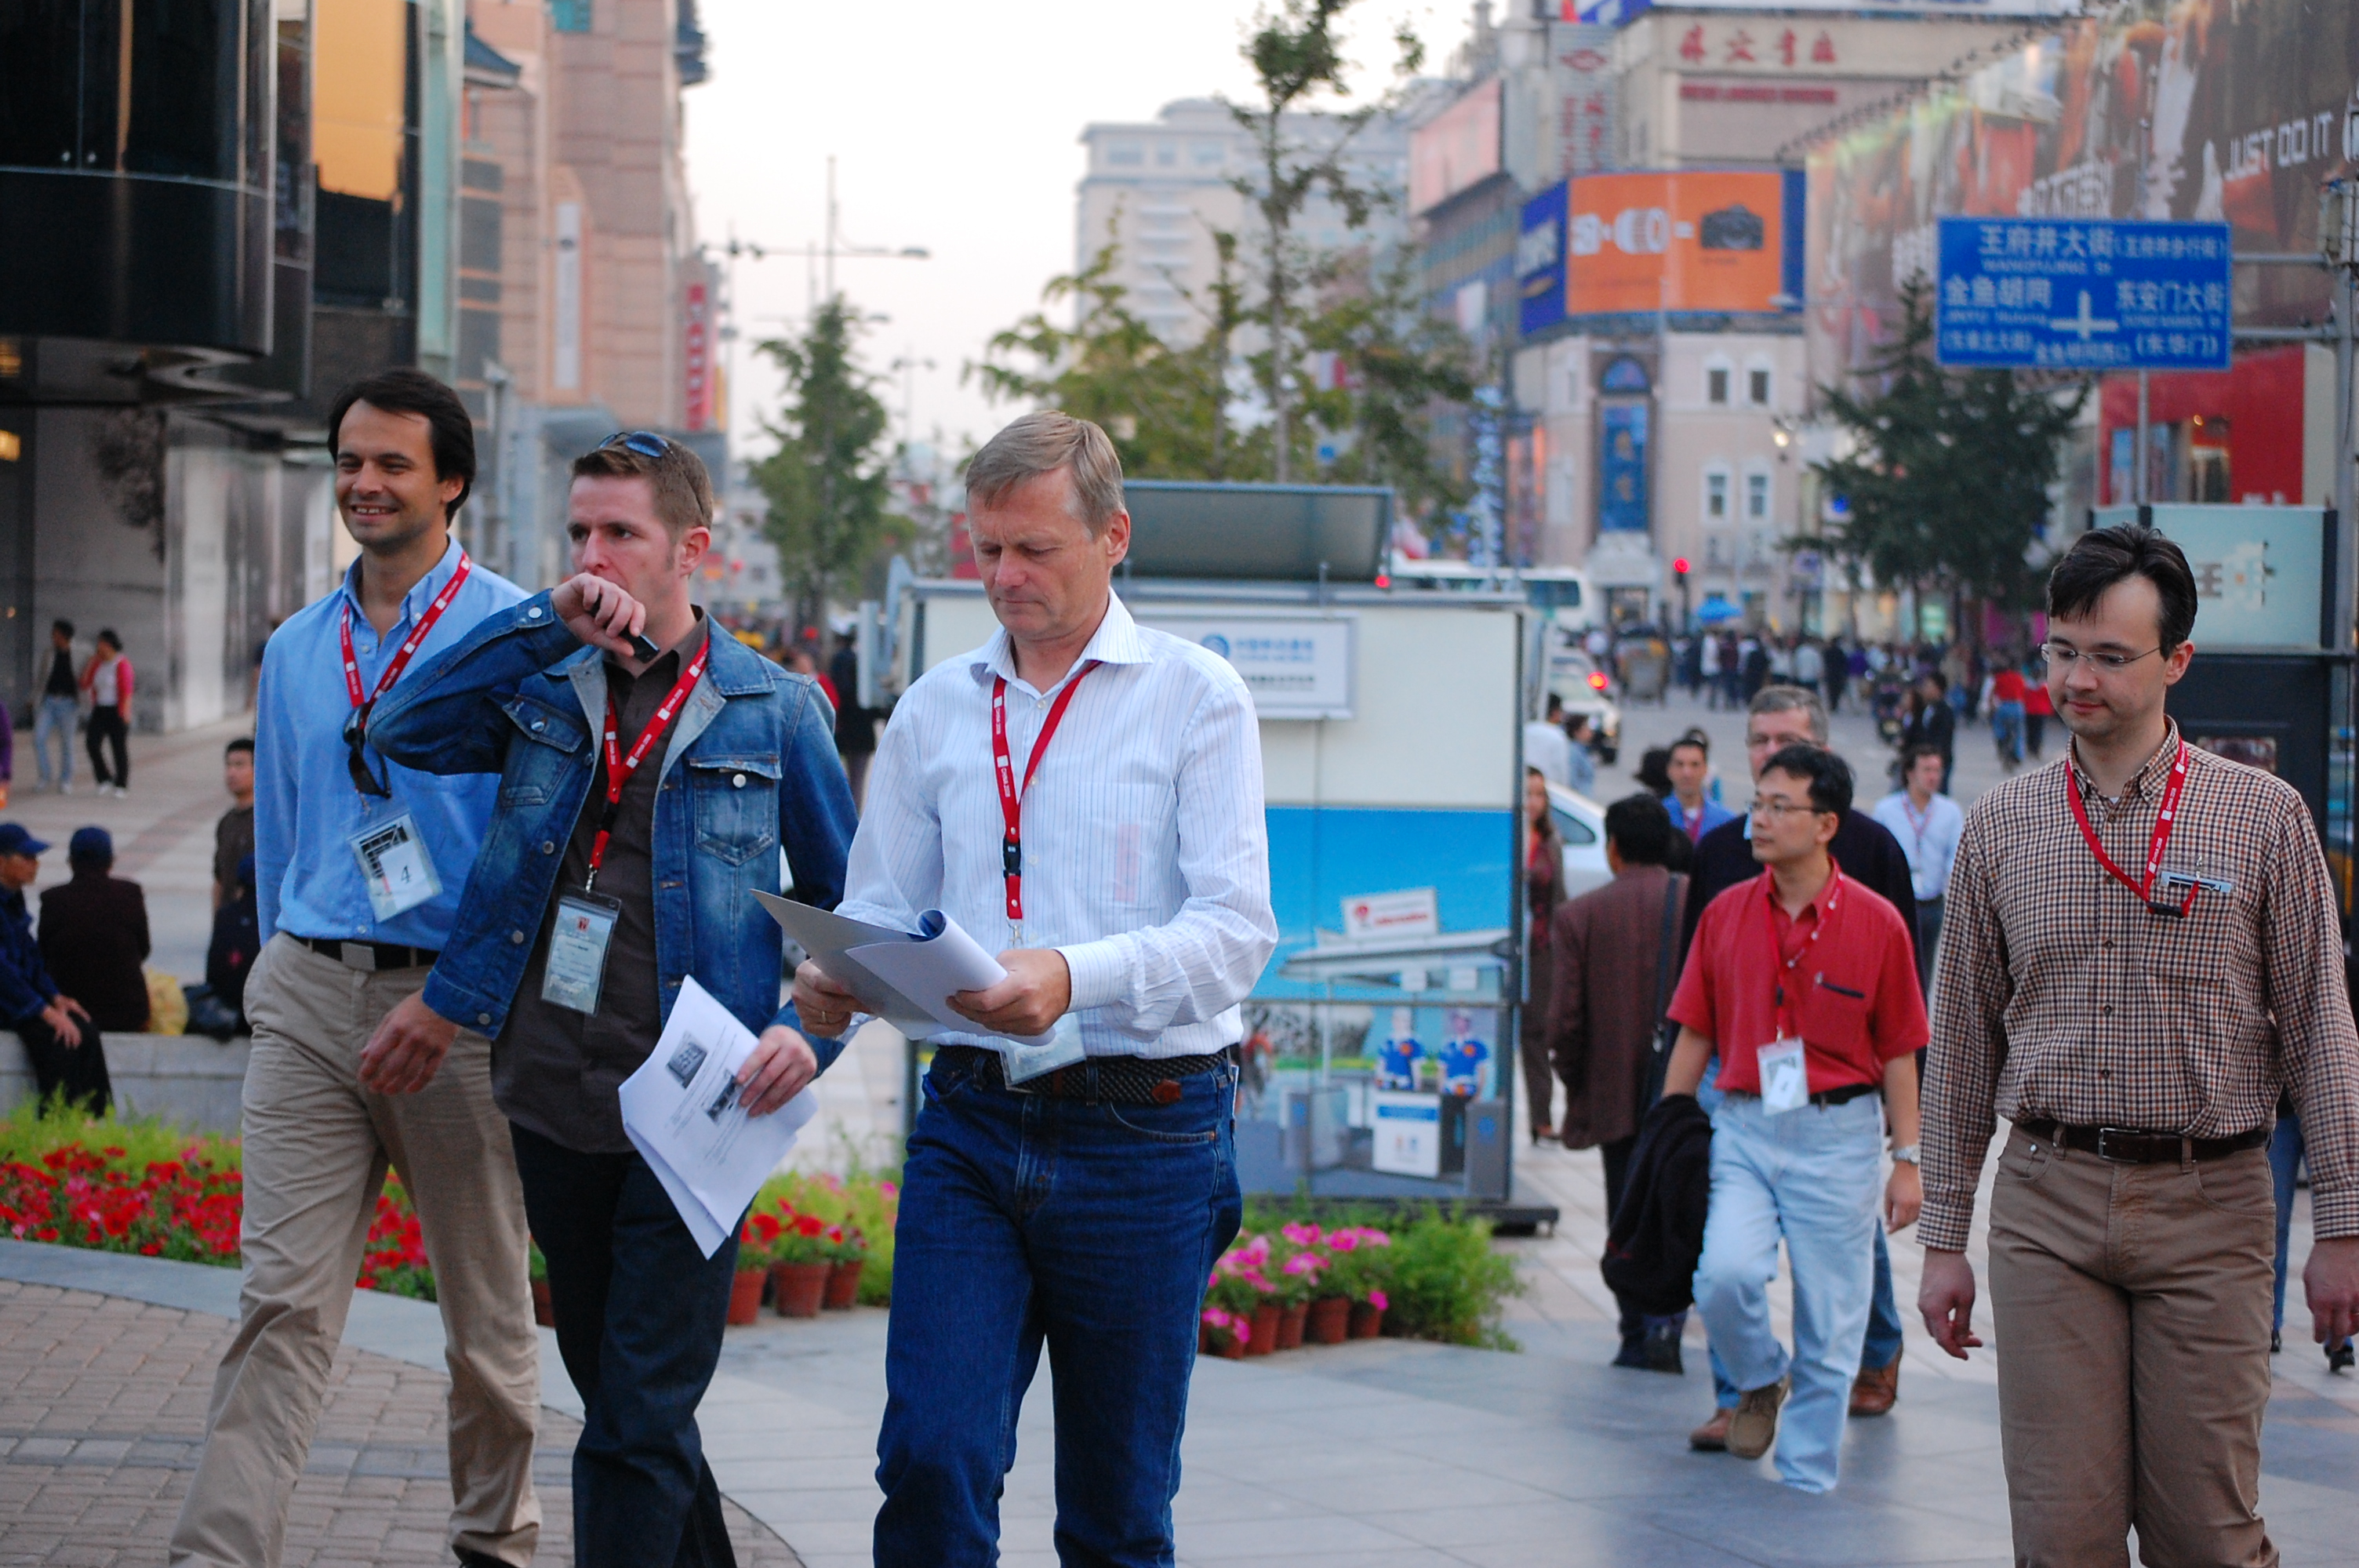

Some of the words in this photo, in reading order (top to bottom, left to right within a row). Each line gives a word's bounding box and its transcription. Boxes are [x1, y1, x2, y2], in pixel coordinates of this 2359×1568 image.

[2224, 129, 2273, 180] JUST
[2277, 118, 2308, 167] DO
[2313, 111, 2333, 158] IT
[1978, 224, 2114, 259] 王府井大街
[1945, 274, 2052, 309] 金鱼胡同
[2116, 280, 2225, 313] 东安门大街
[2135, 332, 2219, 358] (东华门)
[400, 865, 413, 884] 4
